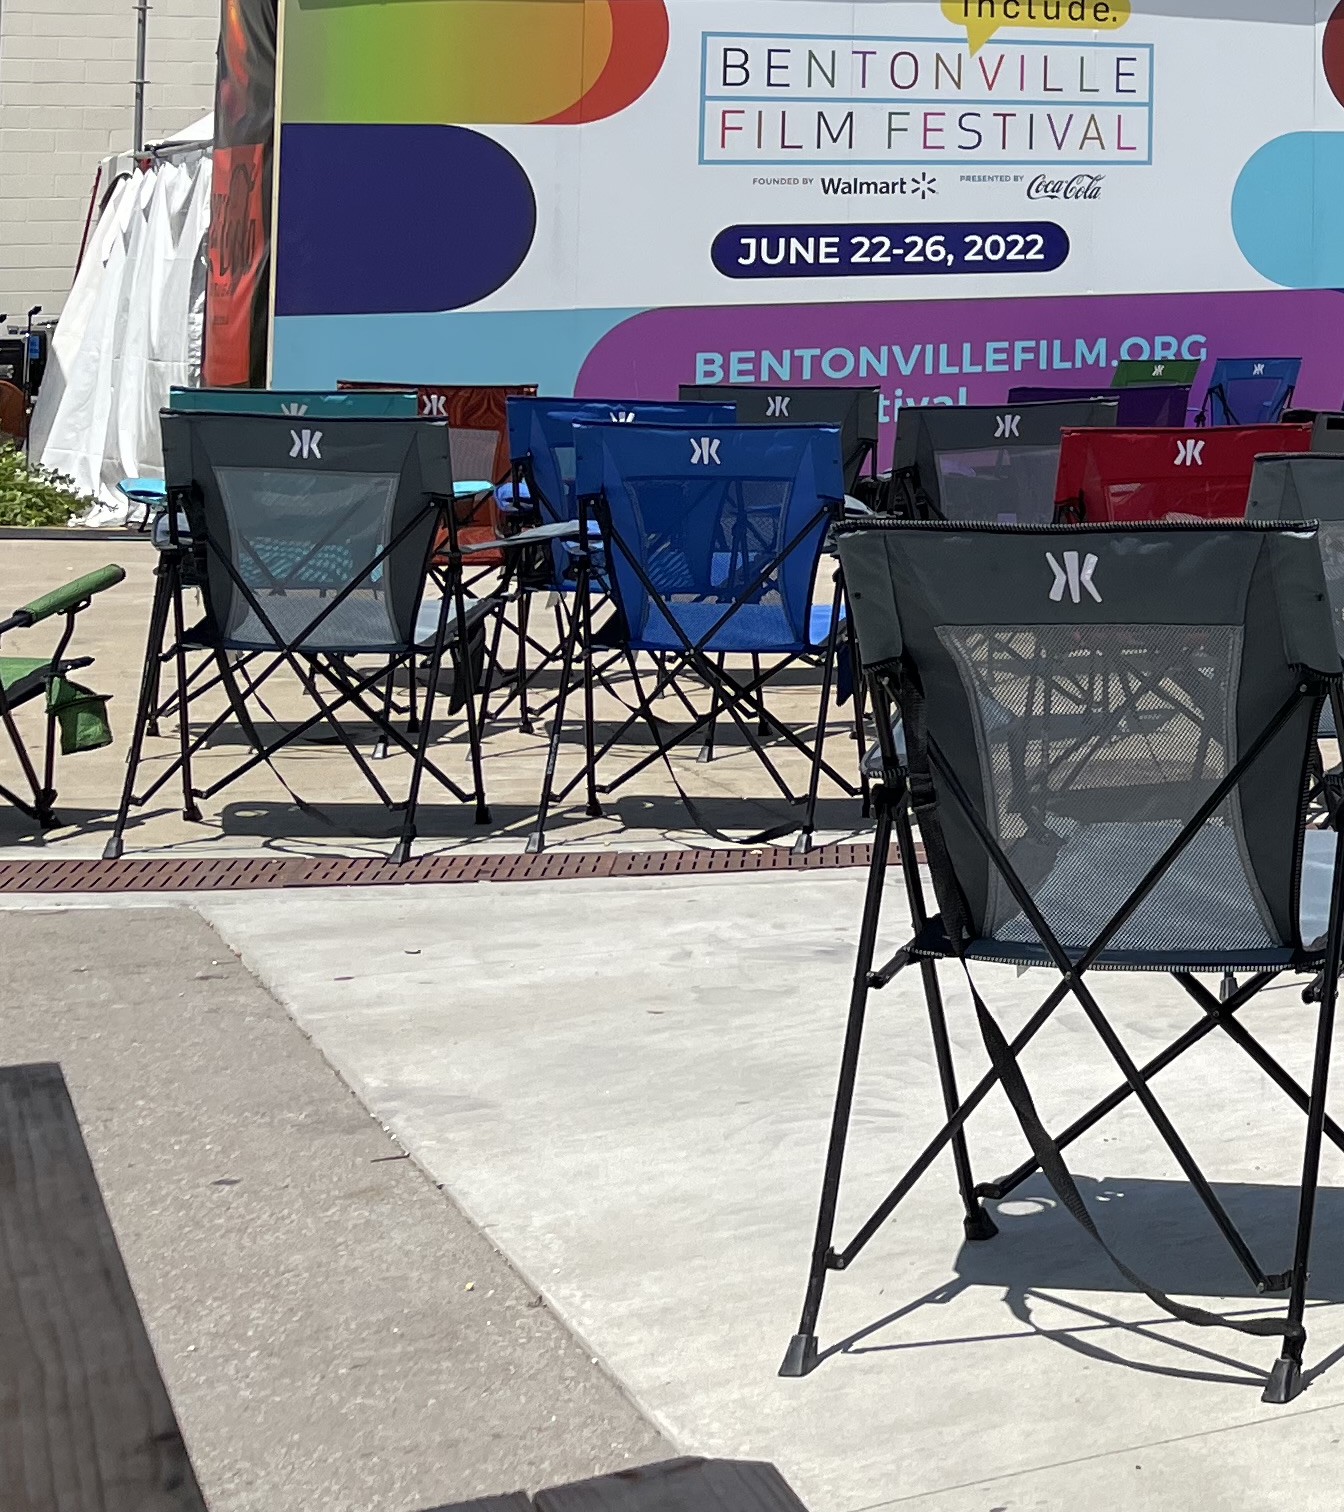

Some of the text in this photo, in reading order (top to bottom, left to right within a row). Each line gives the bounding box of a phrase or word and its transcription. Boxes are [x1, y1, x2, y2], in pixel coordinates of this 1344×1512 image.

[721, 47, 1138, 93] BENTONVILLE
[719, 109, 1138, 151] FILM FESTIVAL
[752, 177, 800, 186] FOUNDED
[801, 176, 815, 186] BY
[820, 176, 908, 196] Walmart
[959, 174, 1011, 183] PRESENTED
[1012, 174, 1025, 183] BY
[737, 233, 1045, 268] JUNE 22-26, 2022
[694, 334, 1208, 386] BENTONVILLEFILM.ORG
